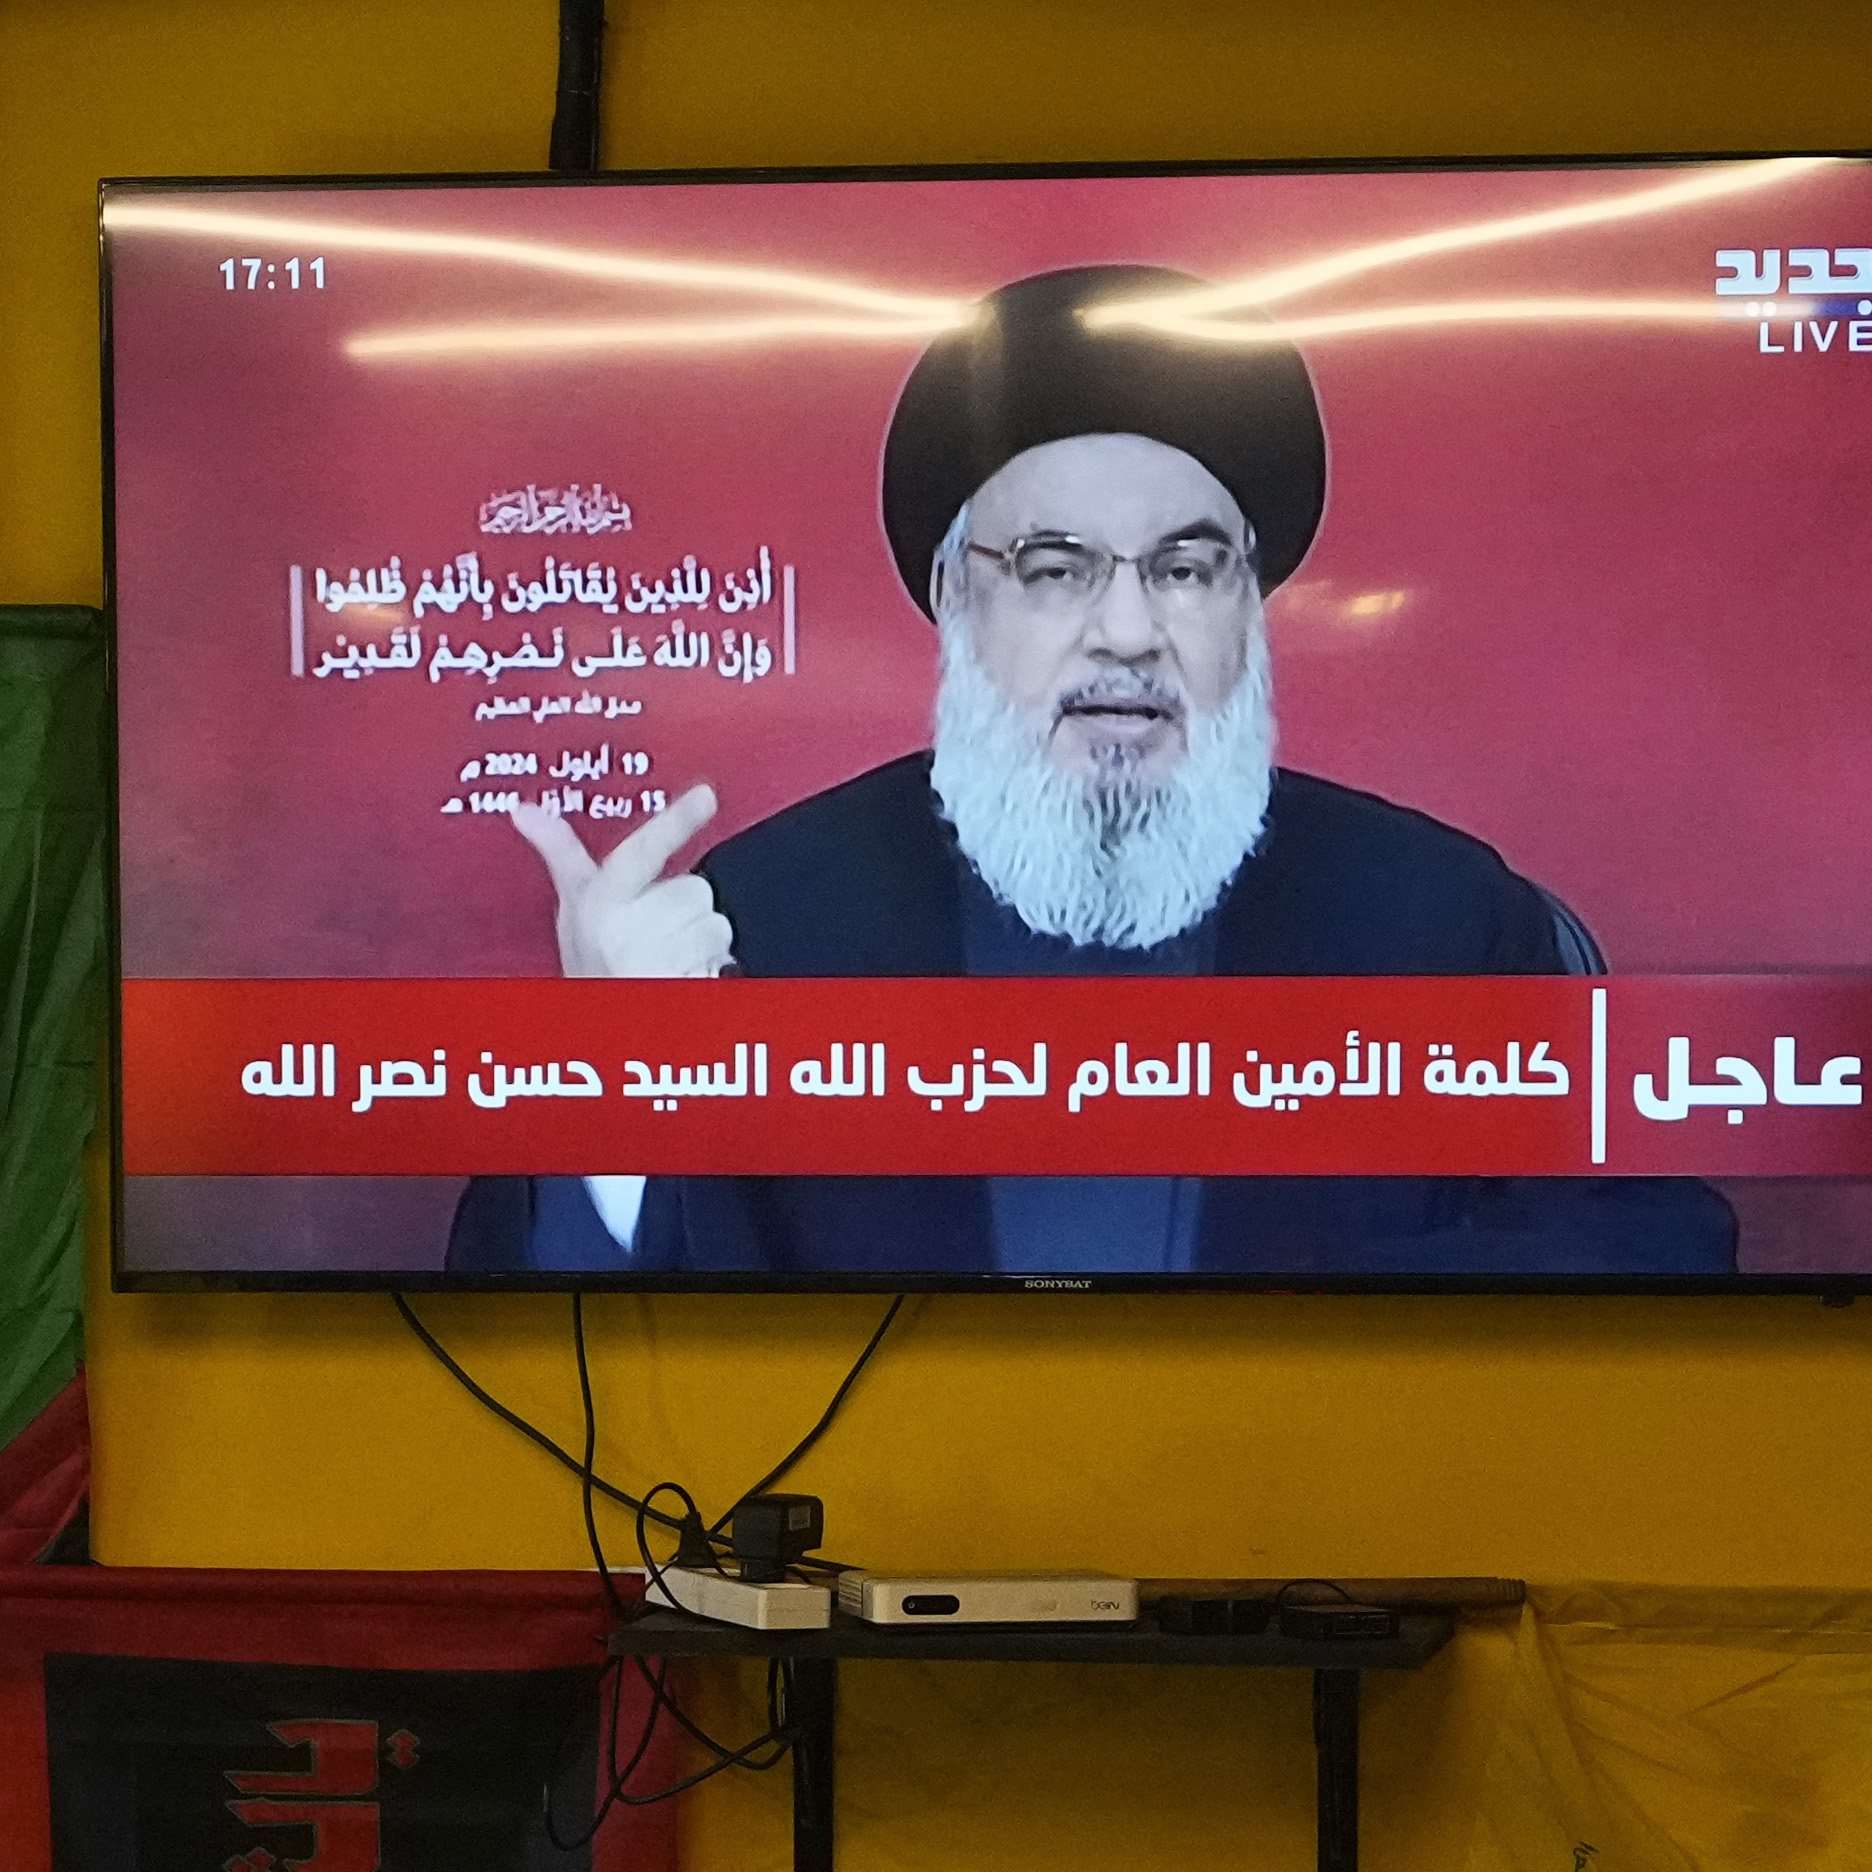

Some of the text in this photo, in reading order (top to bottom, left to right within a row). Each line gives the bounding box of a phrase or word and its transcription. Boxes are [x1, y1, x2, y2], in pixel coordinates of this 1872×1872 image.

[219, 257, 325, 290] 17:11
[485, 752, 538, 775] 2024
[549, 743, 609, 782] أيلول
[622, 752, 649, 775] 19
[241, 1030, 1571, 1112] كلمة الأمين العام لحزب الله السيد حسن نصر الله
[1633, 1036, 1863, 1125] عاجل
